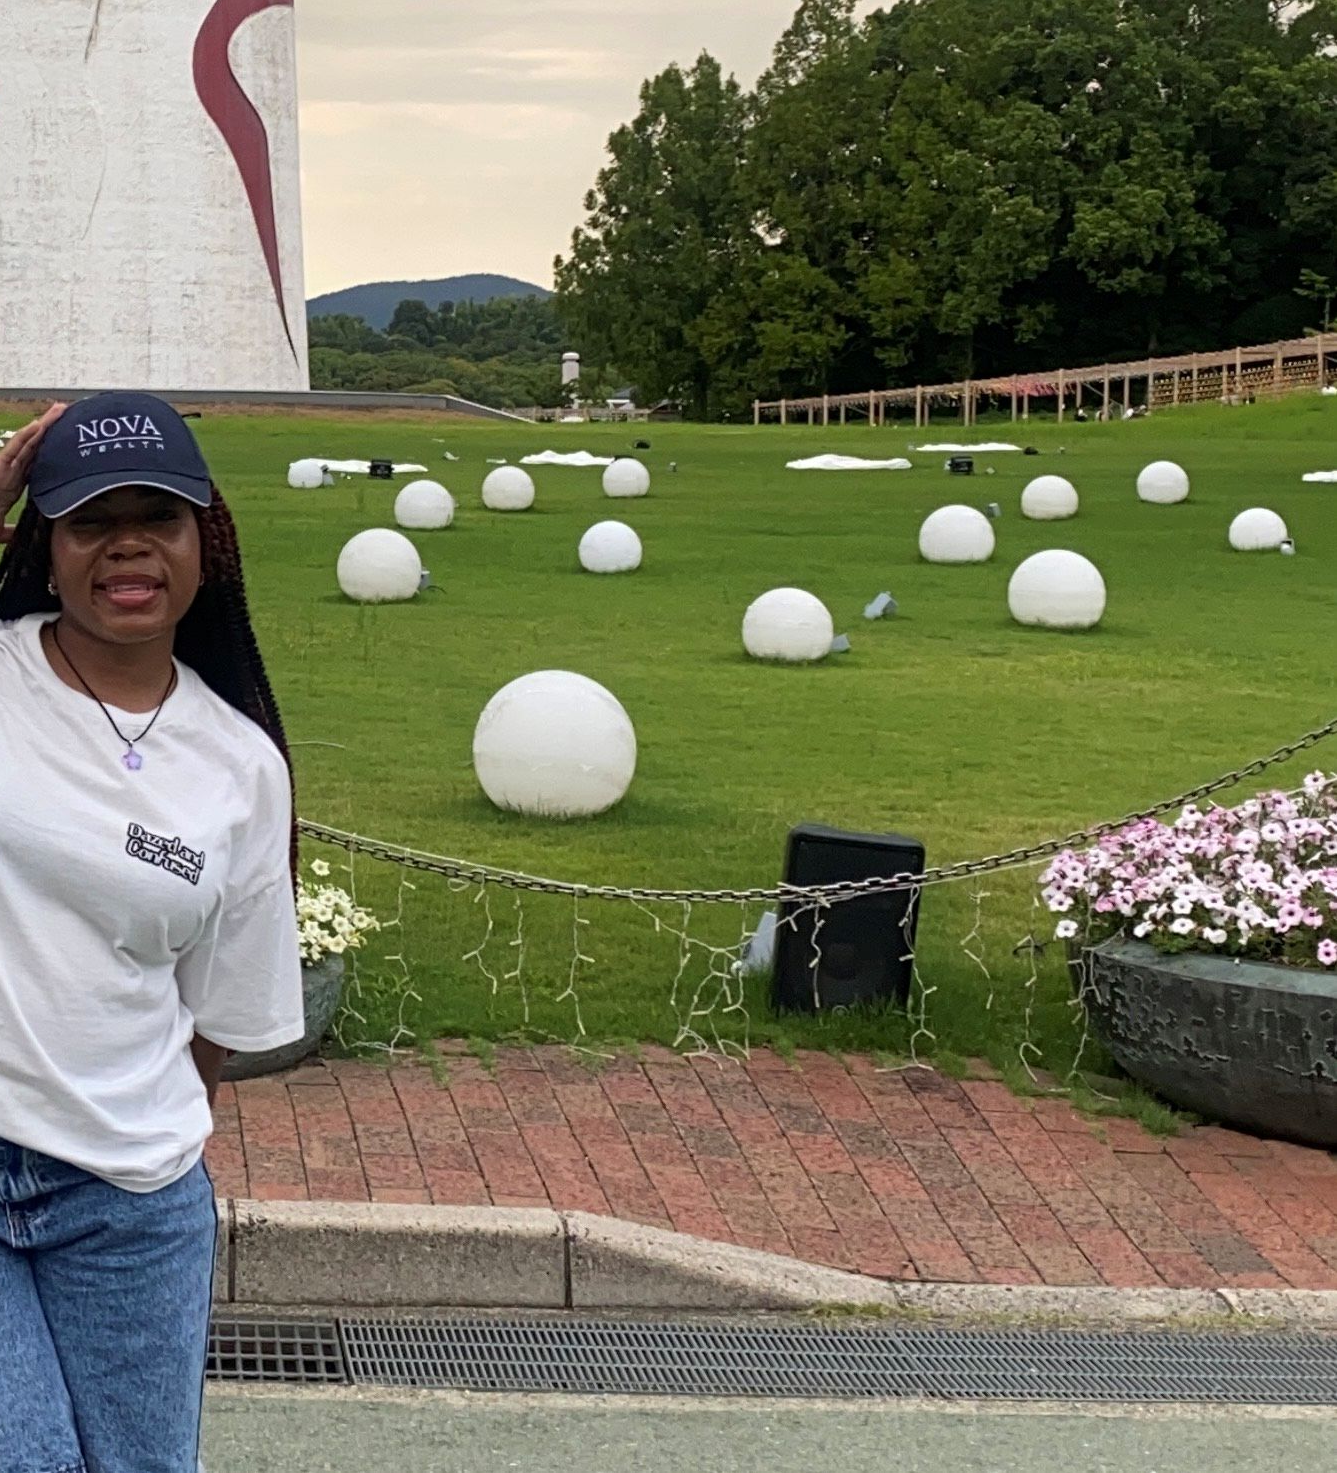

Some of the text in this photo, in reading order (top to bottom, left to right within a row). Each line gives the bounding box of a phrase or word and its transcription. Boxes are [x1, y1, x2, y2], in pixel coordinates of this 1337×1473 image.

[75, 414, 162, 442] NOVA
[79, 441, 165, 457] WEALTH
[125, 837, 201, 886] Confused
[126, 822, 206, 871] Dazed and
